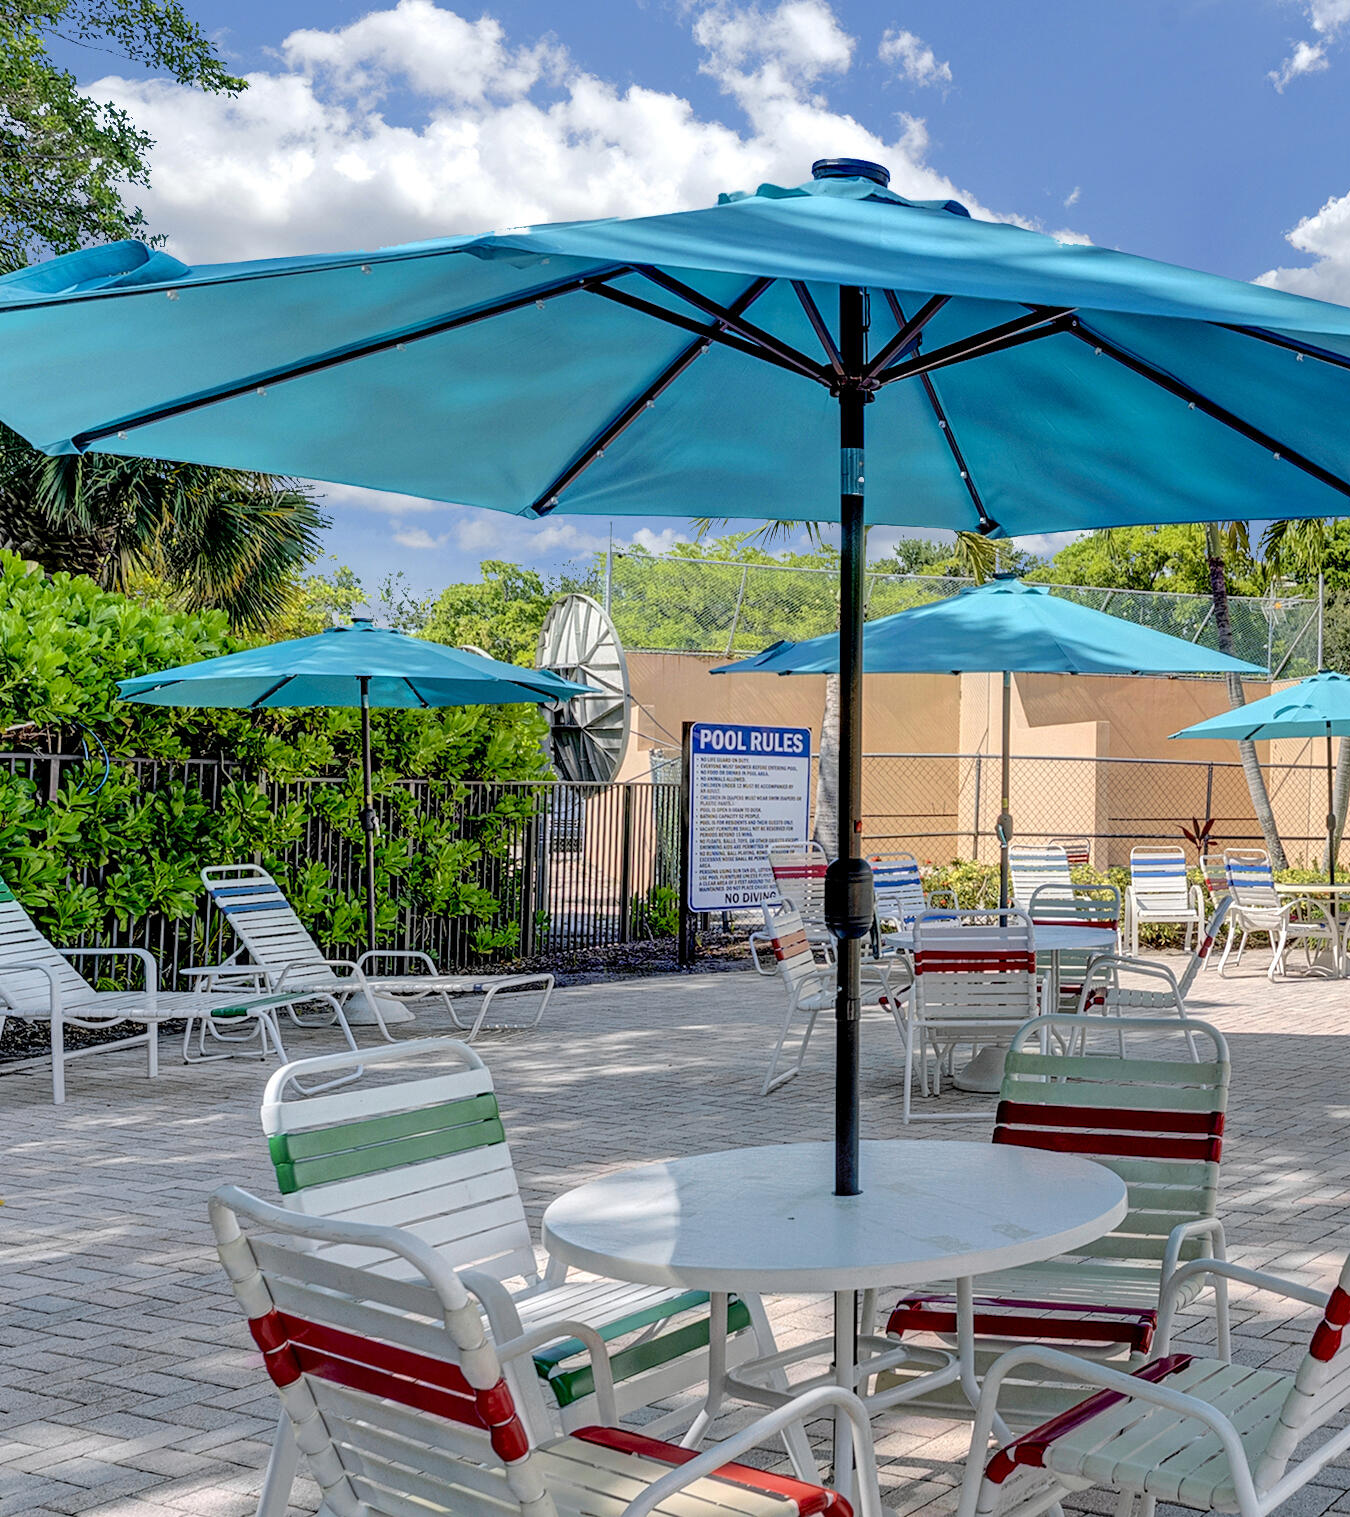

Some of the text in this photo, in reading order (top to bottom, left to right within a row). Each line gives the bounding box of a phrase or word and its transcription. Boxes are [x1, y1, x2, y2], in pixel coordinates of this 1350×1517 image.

[700, 729, 804, 753] POOL RULES
[725, 892, 776, 904] NO DIVING
